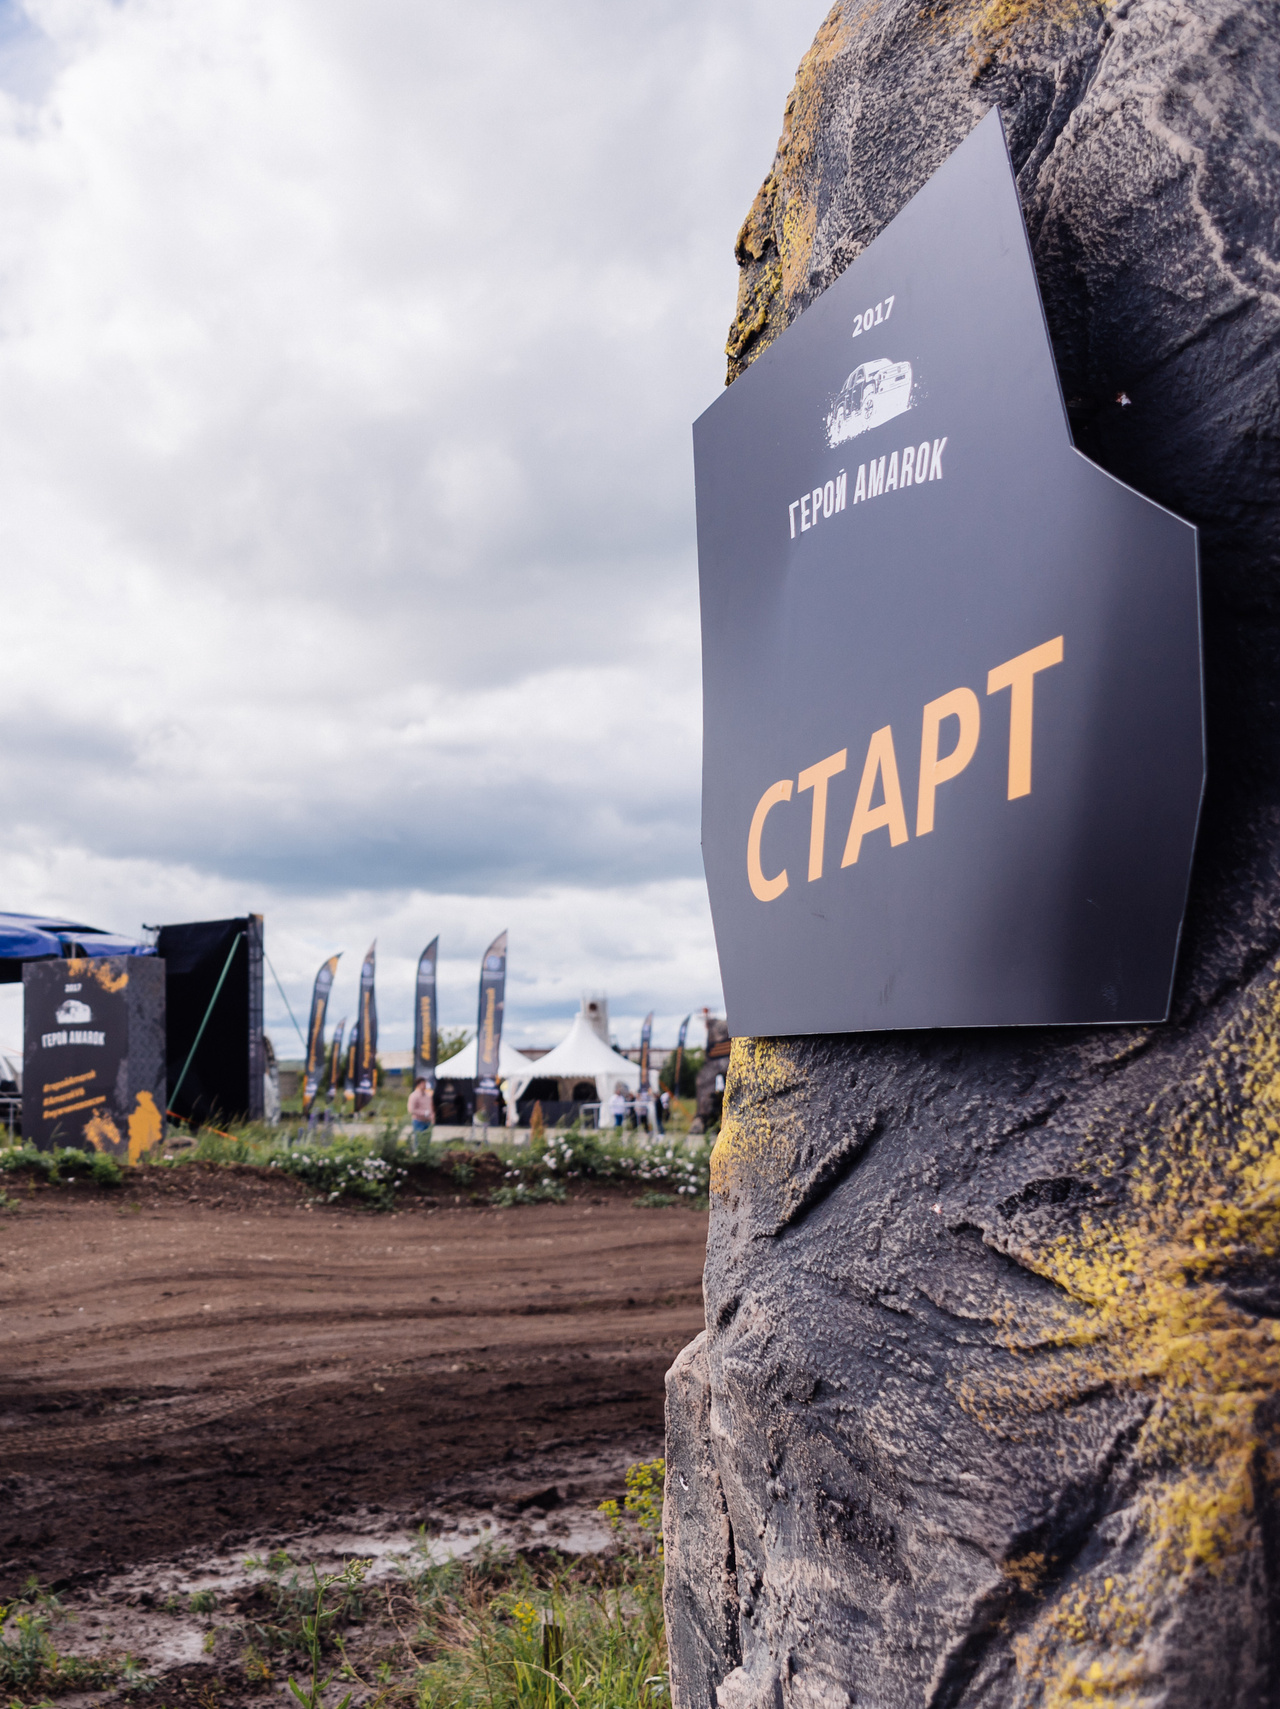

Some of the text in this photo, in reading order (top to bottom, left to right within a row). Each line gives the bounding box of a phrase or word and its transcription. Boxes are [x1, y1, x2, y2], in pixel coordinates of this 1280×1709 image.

[852, 295, 895, 338] 2017
[789, 436, 948, 539] ГЕРОЙ AMAROK
[747, 635, 1063, 902] СТАРТ
